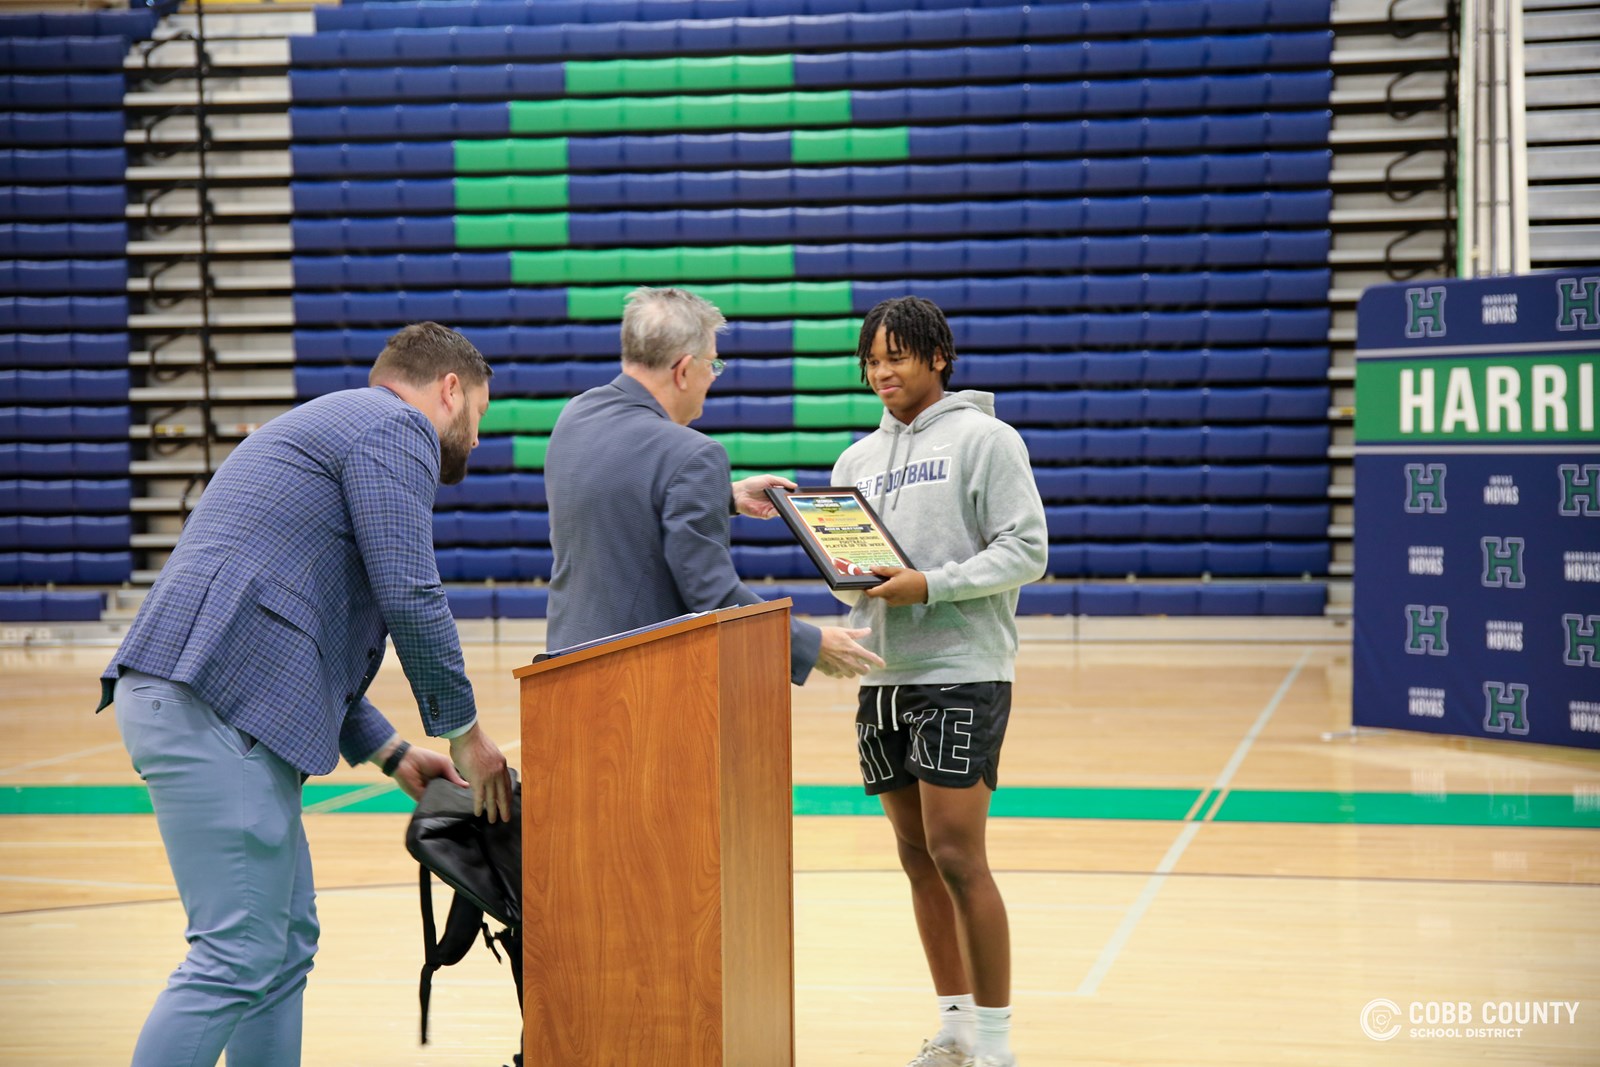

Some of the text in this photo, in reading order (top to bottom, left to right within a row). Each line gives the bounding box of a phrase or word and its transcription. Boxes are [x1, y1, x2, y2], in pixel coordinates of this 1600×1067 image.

[1405, 286, 1447, 338] H
[1482, 304, 1517, 324] HOYAS
[1399, 363, 1595, 434] HARRI
[1404, 463, 1447, 514] H
[1484, 485, 1519, 505] HOYAS
[1480, 536, 1526, 588] H
[1404, 604, 1449, 656] H
[1486, 631, 1523, 652] HOYAS
[1408, 698, 1445, 718] HOYAS
[1482, 681, 1529, 735] H
